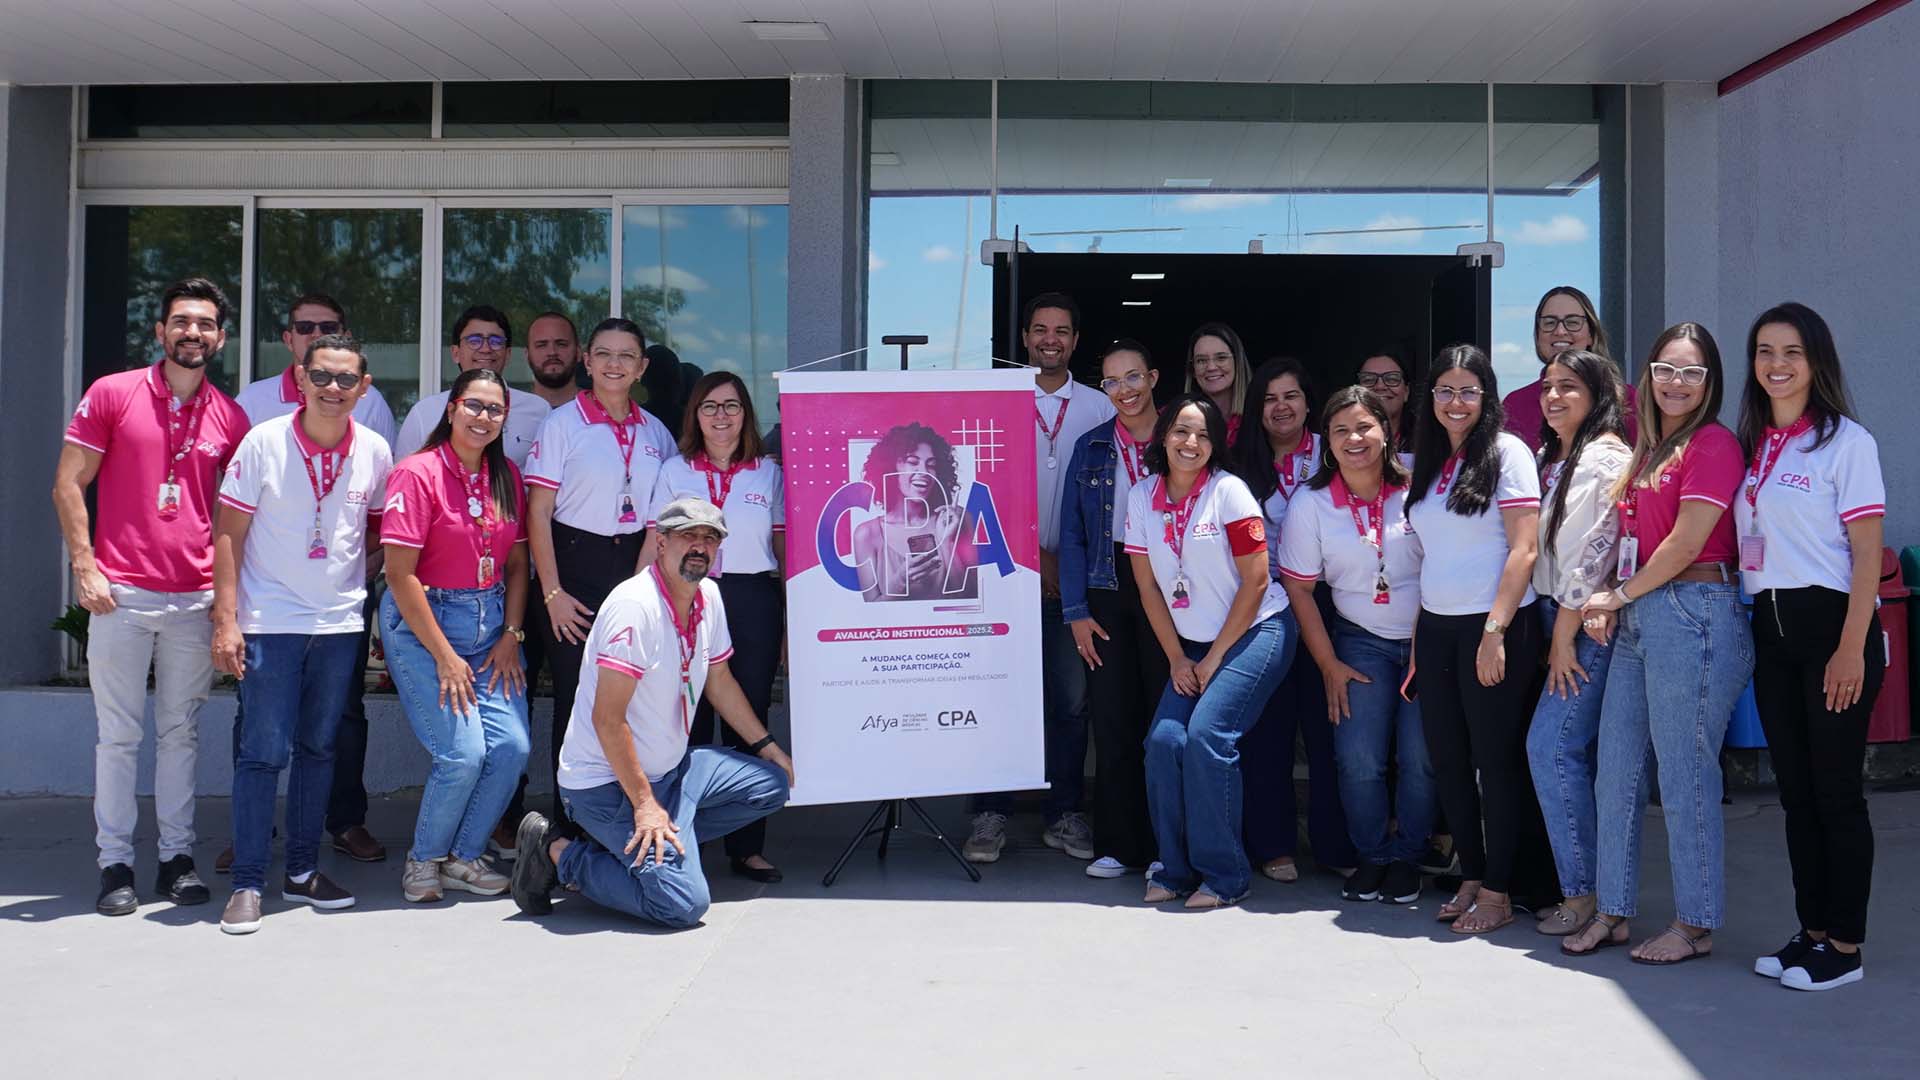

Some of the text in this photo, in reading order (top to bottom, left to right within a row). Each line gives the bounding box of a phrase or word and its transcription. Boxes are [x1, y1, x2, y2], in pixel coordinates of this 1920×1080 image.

[1780, 473, 1810, 488] CPA
[347, 491, 368, 501] CPA
[745, 493, 768, 505] CPA
[1192, 522, 1218, 534] CPA
[816, 472, 1017, 597] CPA
[834, 629, 890, 641] AVALIAÇÃO
[892, 627, 965, 639] INSTITUCIONAL
[870, 654, 913, 663] MUDANÇA
[915, 653, 950, 661] COMEÇA
[952, 652, 971, 660] COM
[881, 664, 899, 672] SUA
[860, 709, 978, 732] Afya CPA
